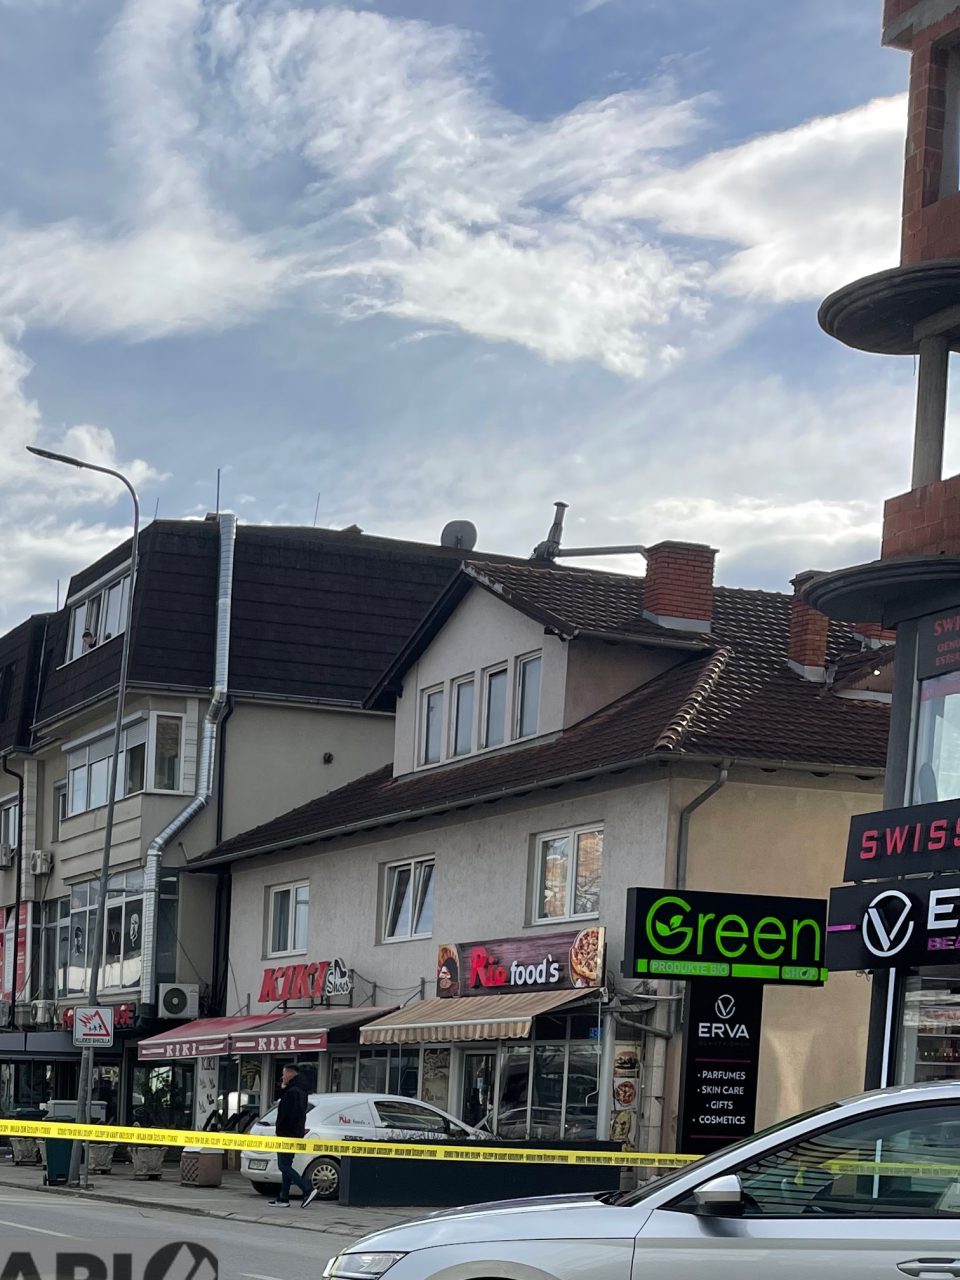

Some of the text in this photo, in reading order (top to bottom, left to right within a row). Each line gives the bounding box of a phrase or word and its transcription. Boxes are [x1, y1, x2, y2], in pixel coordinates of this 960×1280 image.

[646, 896, 821, 961] Green
[469, 946, 509, 989] Rio
[651, 961, 728, 976] PRODUKTE BIO
[258, 961, 332, 1003] KIKI
[698, 1022, 750, 1039] ERVA
[166, 1043, 198, 1057] KIKI
[258, 1036, 296, 1051] KIKI
[702, 1070, 746, 1080] PARFUMES
[701, 1085, 745, 1095] SKIN CARE
[710, 1101, 733, 1110] GIFTS
[699, 1115, 746, 1125] COSMETICS
